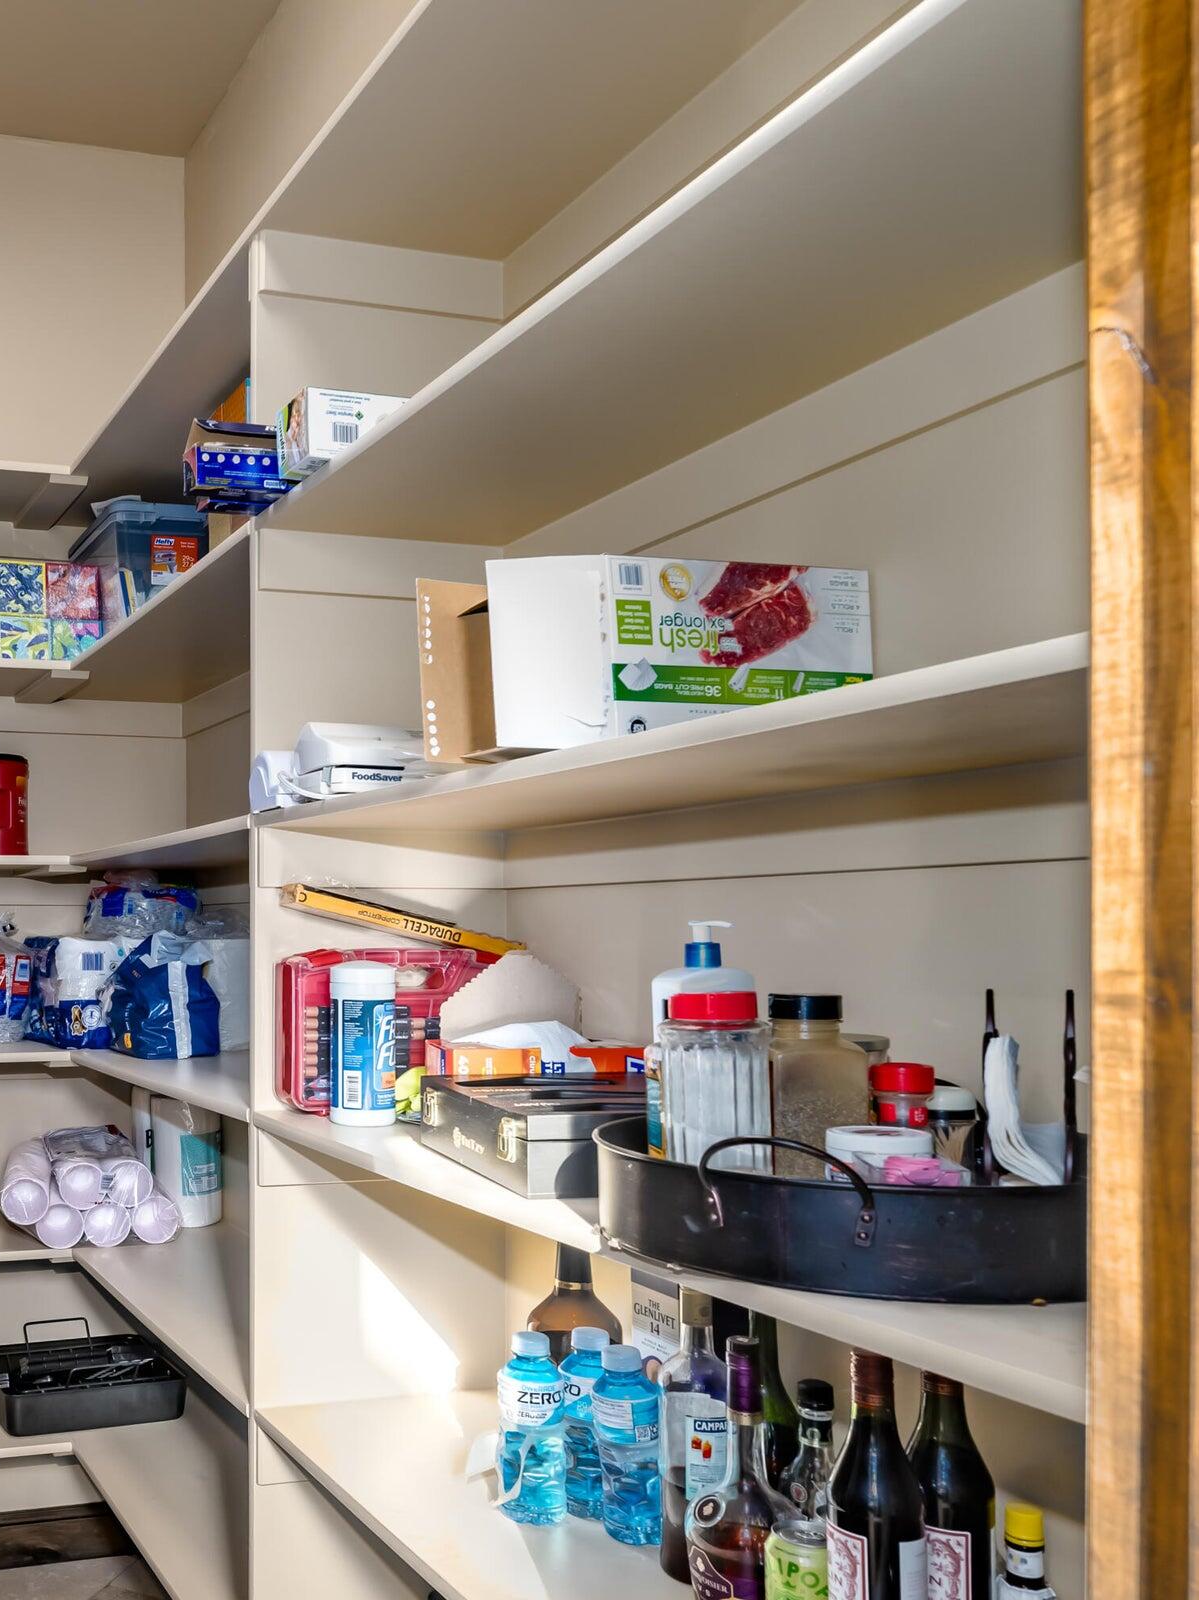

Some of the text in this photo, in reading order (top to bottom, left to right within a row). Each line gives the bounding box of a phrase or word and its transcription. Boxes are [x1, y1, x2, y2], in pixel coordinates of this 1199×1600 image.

[155, 538, 174, 546] Hefty
[658, 612, 706, 632] longer
[709, 618, 726, 632] 5x
[658, 628, 719, 657] fresh
[704, 685, 722, 697] 36
[351, 771, 403, 783] FoodSaver
[297, 892, 308, 903] C
[357, 909, 462, 943] DURACELL COPPERTOP
[528, 1055, 537, 1074] Citru
[648, 1299, 661, 1311] THE
[634, 1302, 676, 1330] GLENLIVET
[649, 1322, 660, 1336] 14
[517, 1390, 563, 1405] ZERO
[695, 1420, 728, 1432] CAMPA
